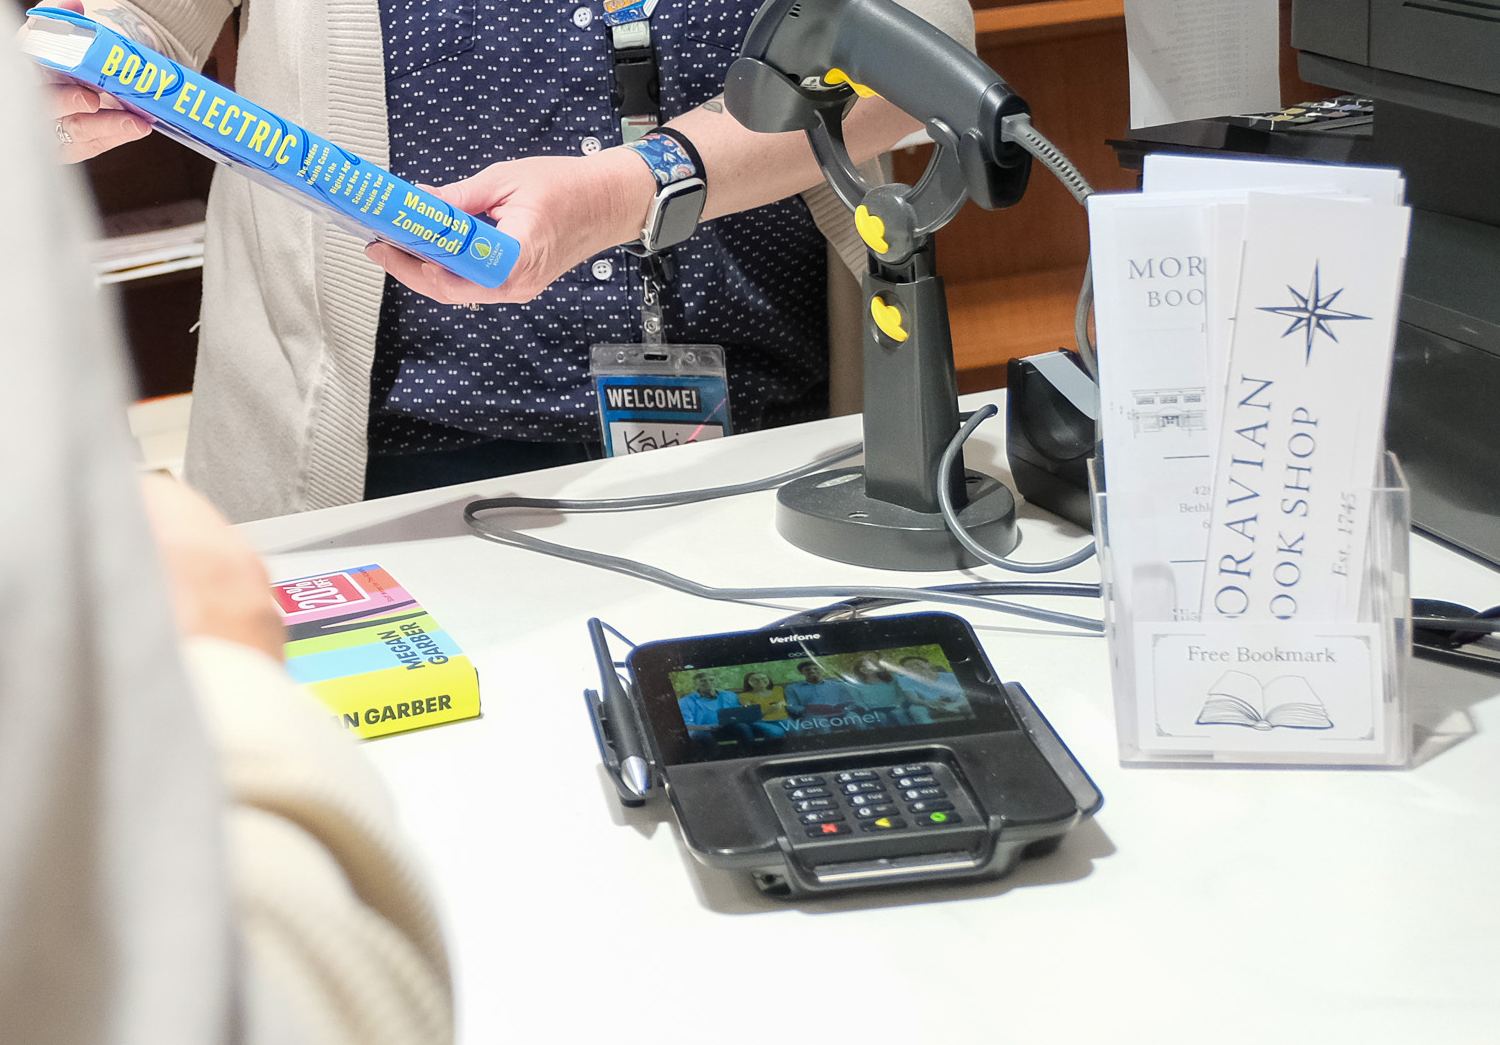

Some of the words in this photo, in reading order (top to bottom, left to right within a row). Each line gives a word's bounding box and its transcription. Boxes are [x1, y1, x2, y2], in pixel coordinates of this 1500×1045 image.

[100, 44, 176, 101] BODY
[172, 81, 298, 165] ELECTRIC
[296, 165, 308, 178] The
[306, 165, 322, 185] Health
[324, 173, 331, 182] of
[327, 162, 337, 174] the
[329, 172, 345, 194] Digital
[343, 183, 354, 196] and
[351, 179, 369, 204] Science
[364, 172, 372, 180] to
[360, 188, 378, 213] Reclaim
[403, 191, 469, 236] Manoush
[391, 210, 463, 255] Zomorodi
[606, 388, 698, 410] WELCOME!
[1280, 407, 1318, 518] SHOP
[1337, 491, 1357, 534] 1745
[282, 581, 348, 610] 20%
[377, 629, 426, 671] MEGAN
[399, 621, 450, 666] GARBER
[769, 632, 821, 645] Verifone
[1186, 644, 1230, 663] Free
[1236, 646, 1337, 664] Bookmark
[364, 694, 453, 726] GARBER
[779, 710, 881, 732] Welcome!
